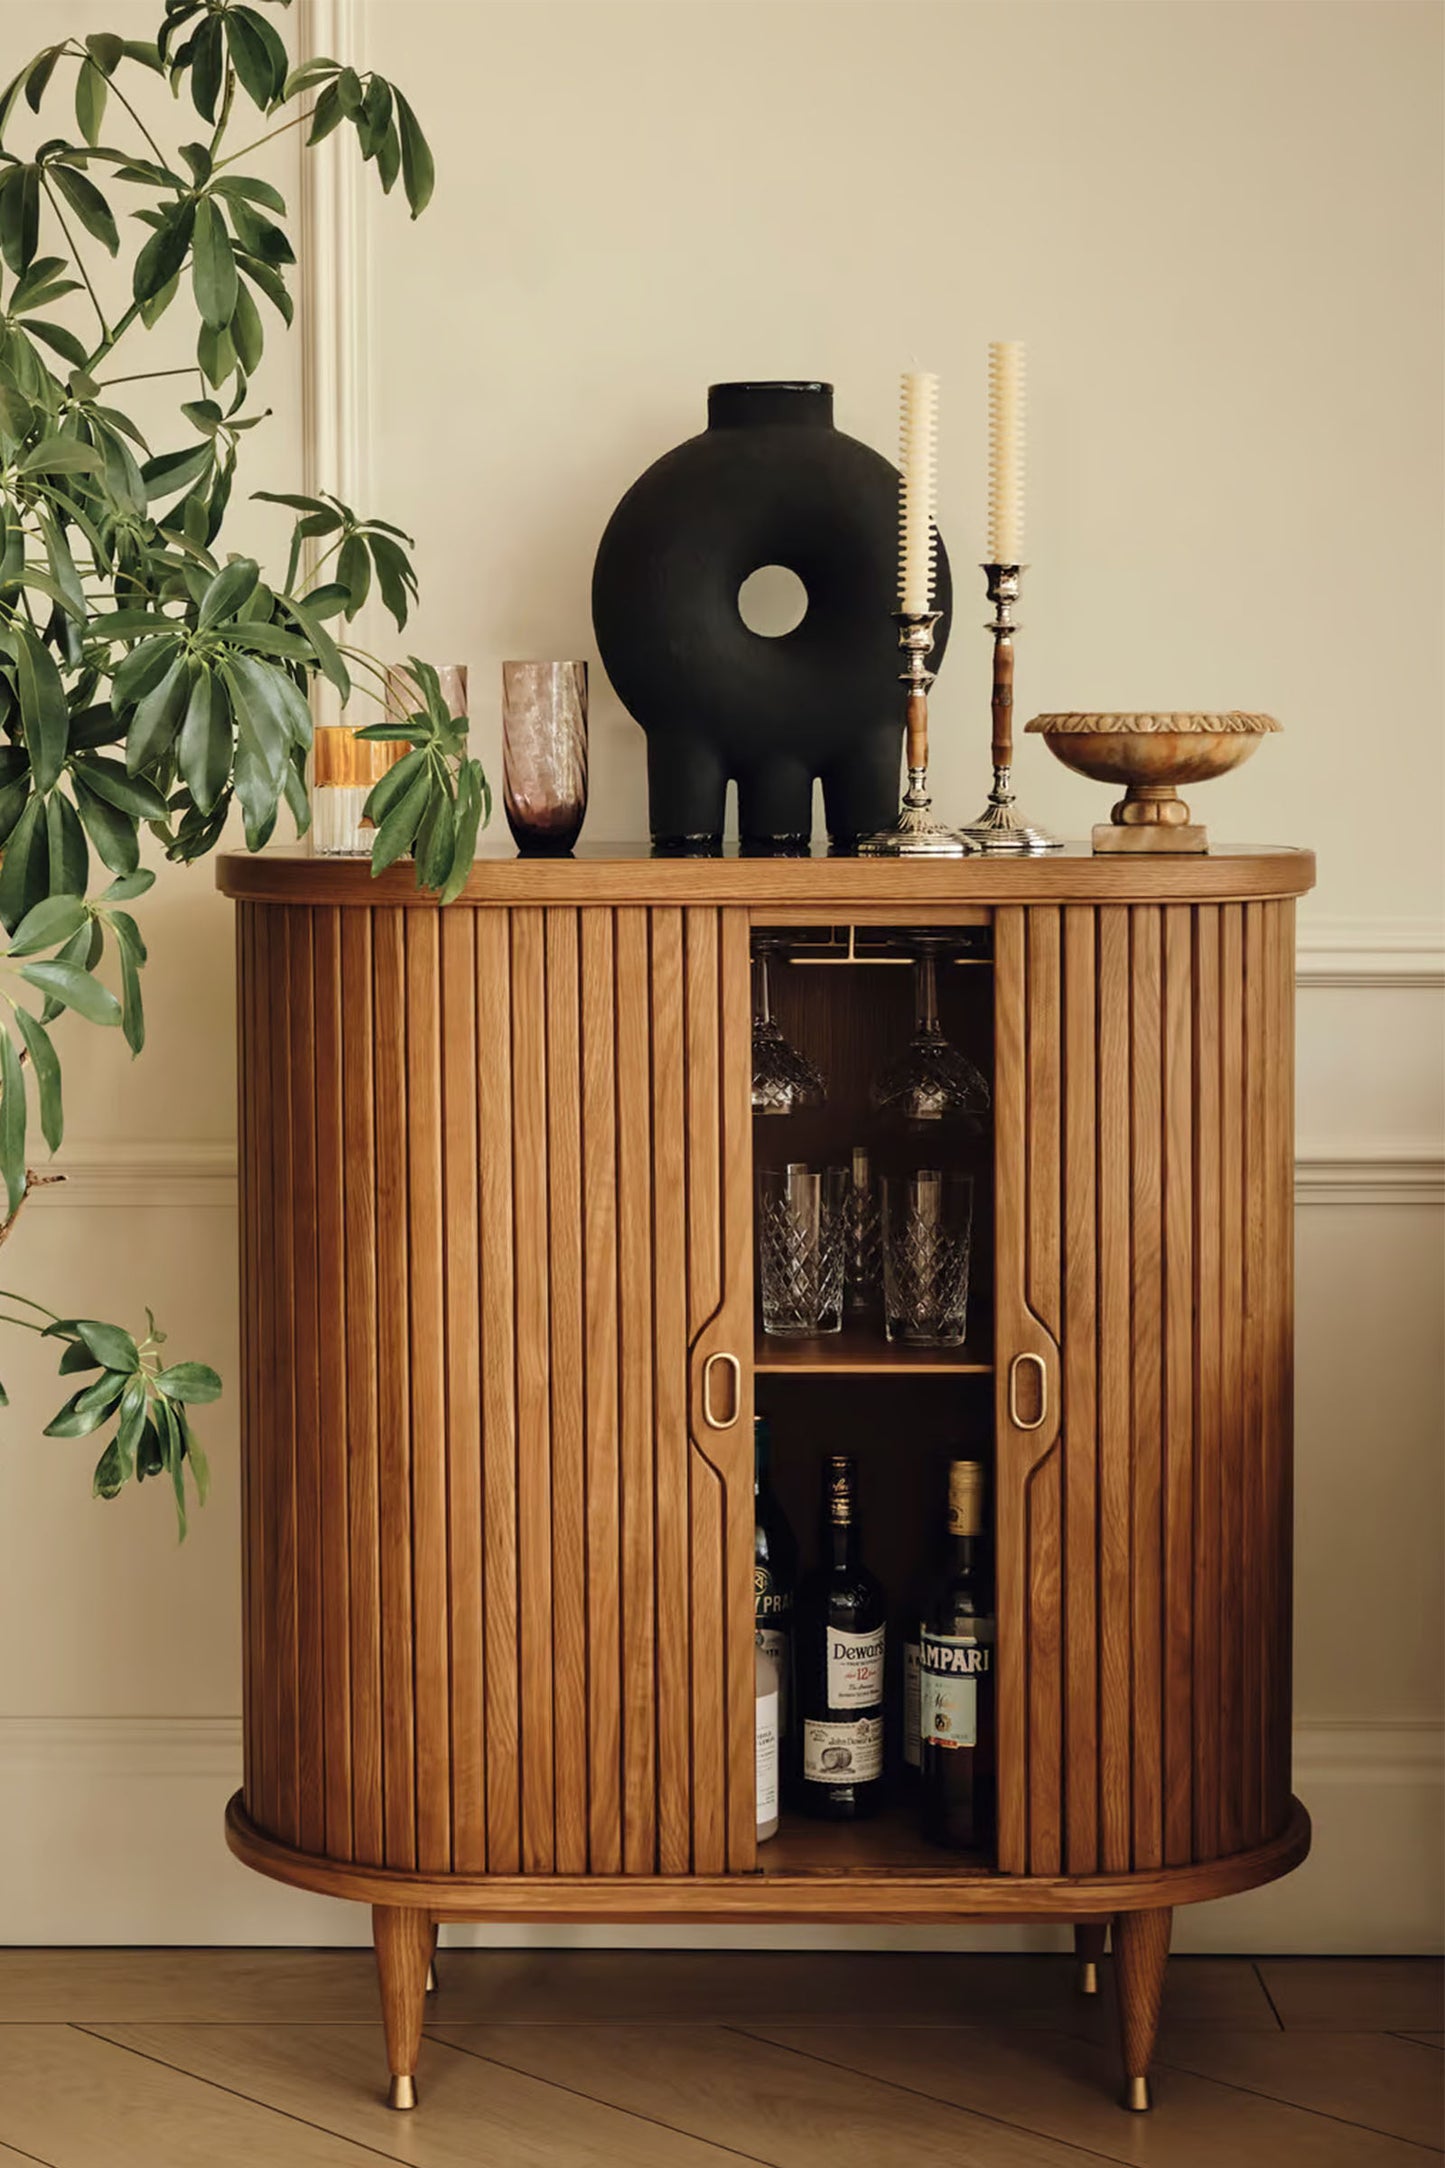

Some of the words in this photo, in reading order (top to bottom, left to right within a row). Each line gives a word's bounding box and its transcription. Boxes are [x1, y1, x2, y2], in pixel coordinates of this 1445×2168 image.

[763, 1592, 793, 1613] PRA
[921, 1641, 989, 1672] AMPARI
[857, 1667, 868, 1681] 12
